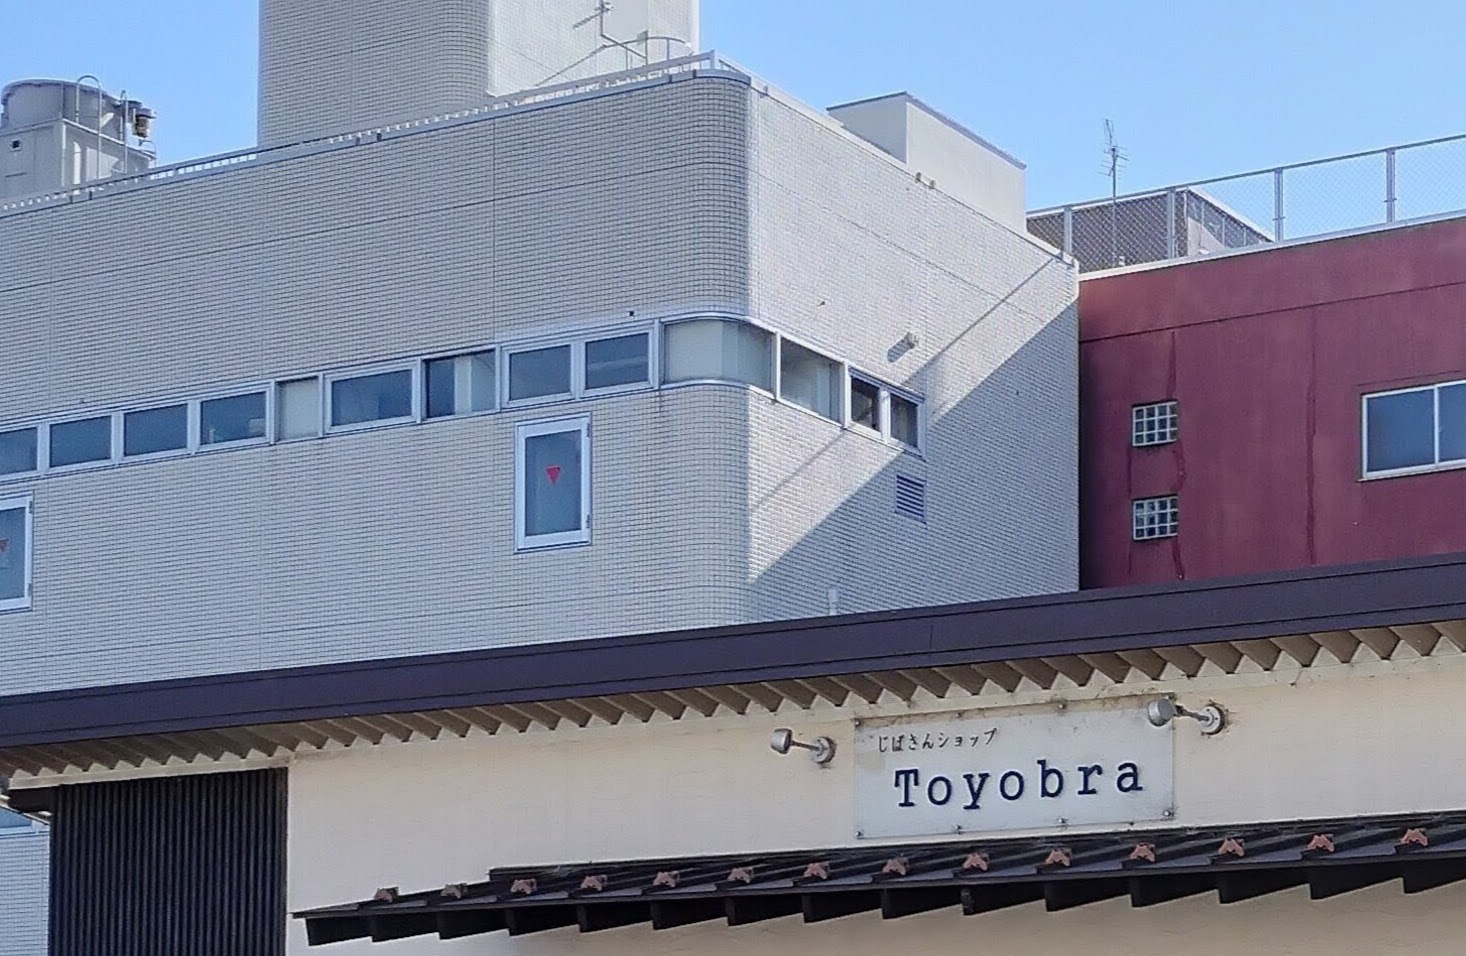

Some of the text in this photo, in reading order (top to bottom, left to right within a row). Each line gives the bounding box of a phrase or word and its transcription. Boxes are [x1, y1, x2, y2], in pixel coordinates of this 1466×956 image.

[877, 727, 998, 753] じばさんショップ
[893, 758, 1144, 810] Toyobra
